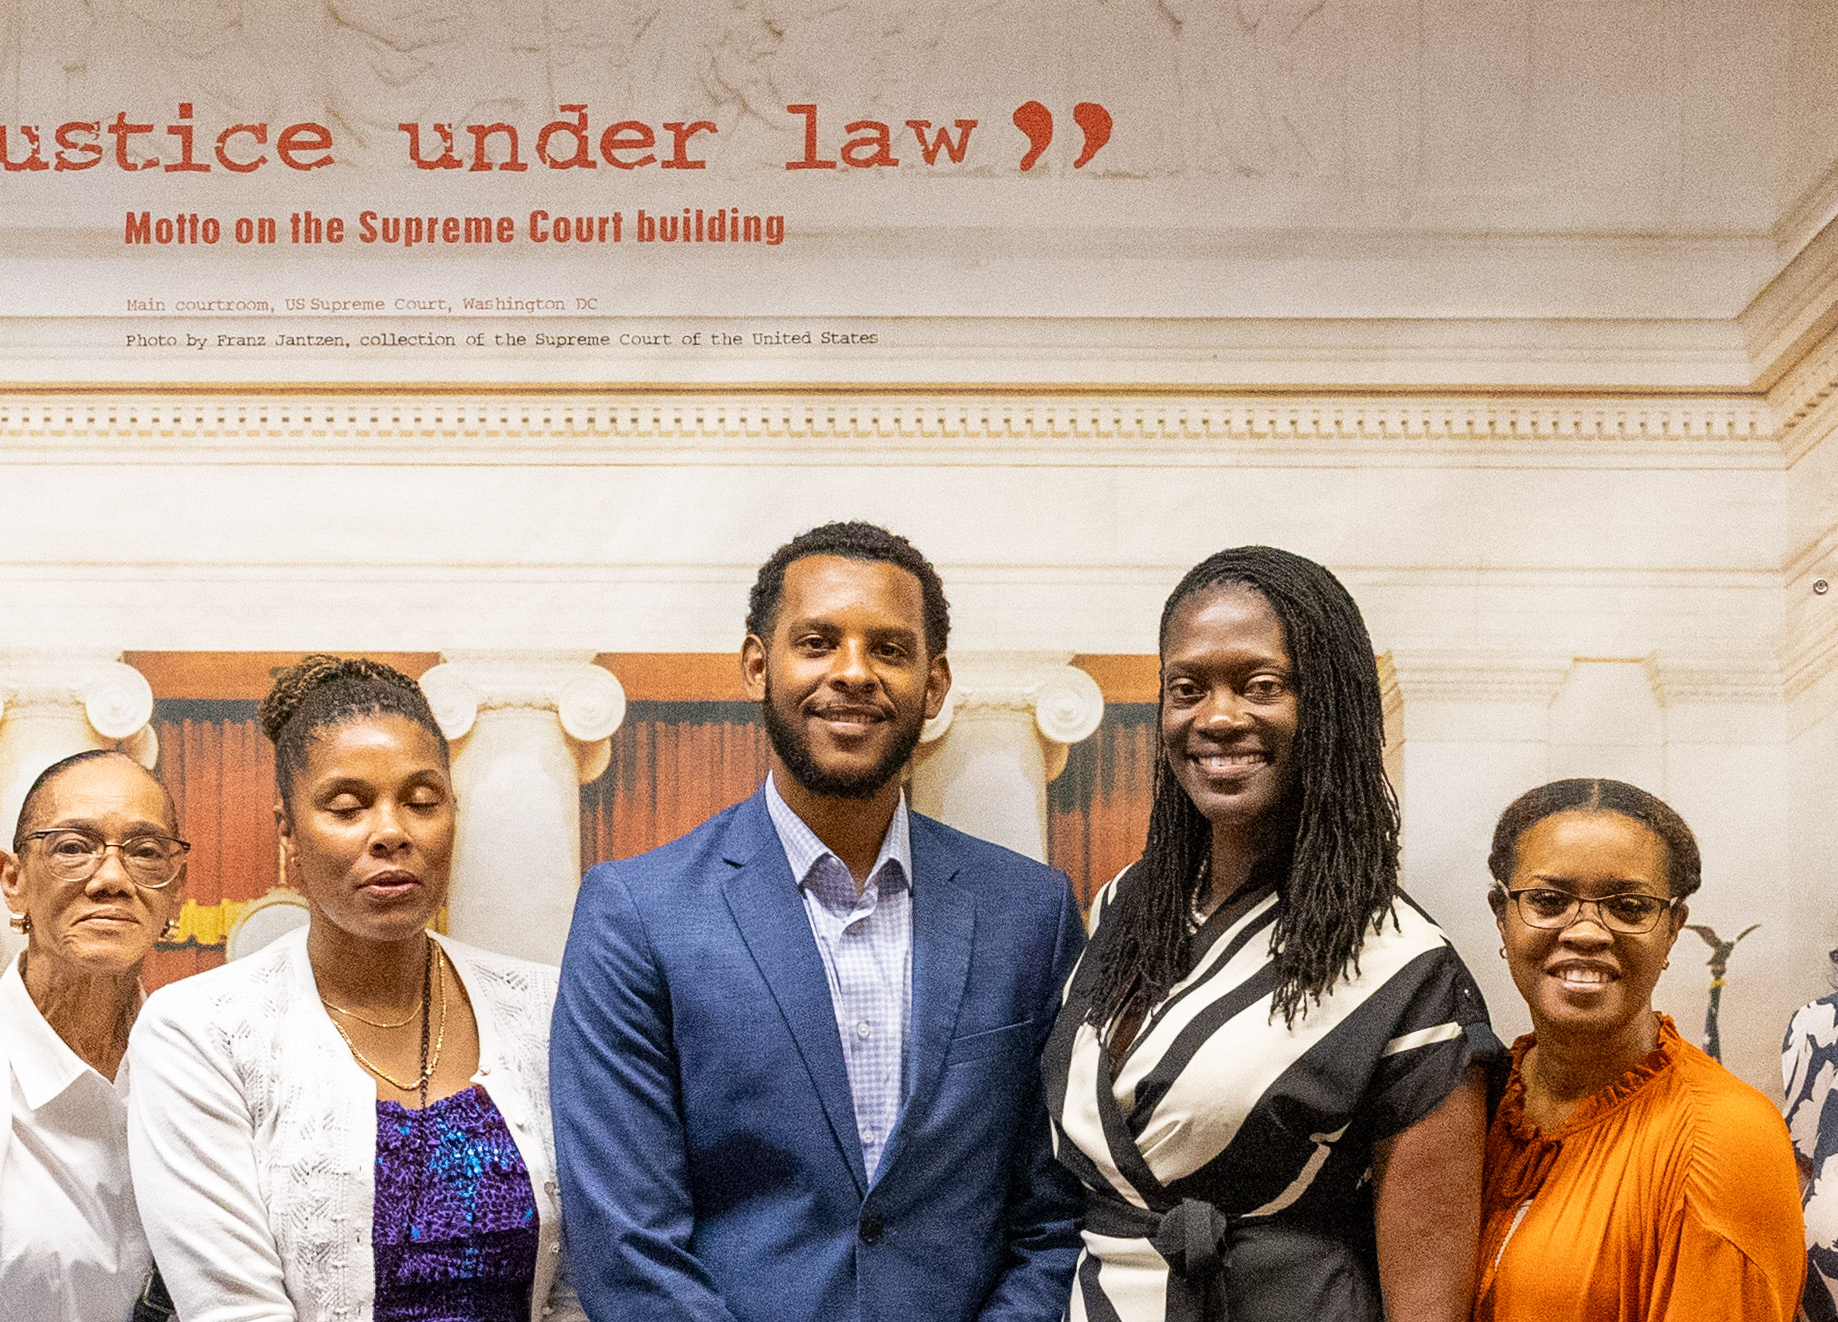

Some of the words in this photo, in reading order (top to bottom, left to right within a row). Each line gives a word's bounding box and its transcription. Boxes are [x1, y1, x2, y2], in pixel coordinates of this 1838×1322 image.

[399, 105, 714, 171] under
[125, 213, 220, 244] Motto
[235, 218, 276, 244] on
[291, 212, 343, 243] the
[360, 211, 514, 247] Supreme
[529, 211, 622, 243] Court
[637, 210, 784, 245] building
[127, 299, 165, 313] Main
[176, 299, 276, 313] courtroom,
[286, 299, 305, 313] US
[310, 299, 385, 313] Supreme
[394, 299, 453, 313] Court,
[463, 299, 565, 313] Washington
[576, 299, 598, 310] DC
[126, 333, 177, 349] Photo
[187, 333, 208, 349] by
[218, 333, 266, 349] Franz
[276, 333, 351, 349] Jantzen,
[360, 333, 456, 349] collection
[465, 333, 485, 349] of
[495, 333, 527, 348] the
[535, 333, 610, 348] Supreme
[620, 333, 672, 348] Court
[682, 333, 702, 348] of
[712, 333, 743, 348] the
[754, 333, 812, 348] United
[821, 333, 879, 348] States
